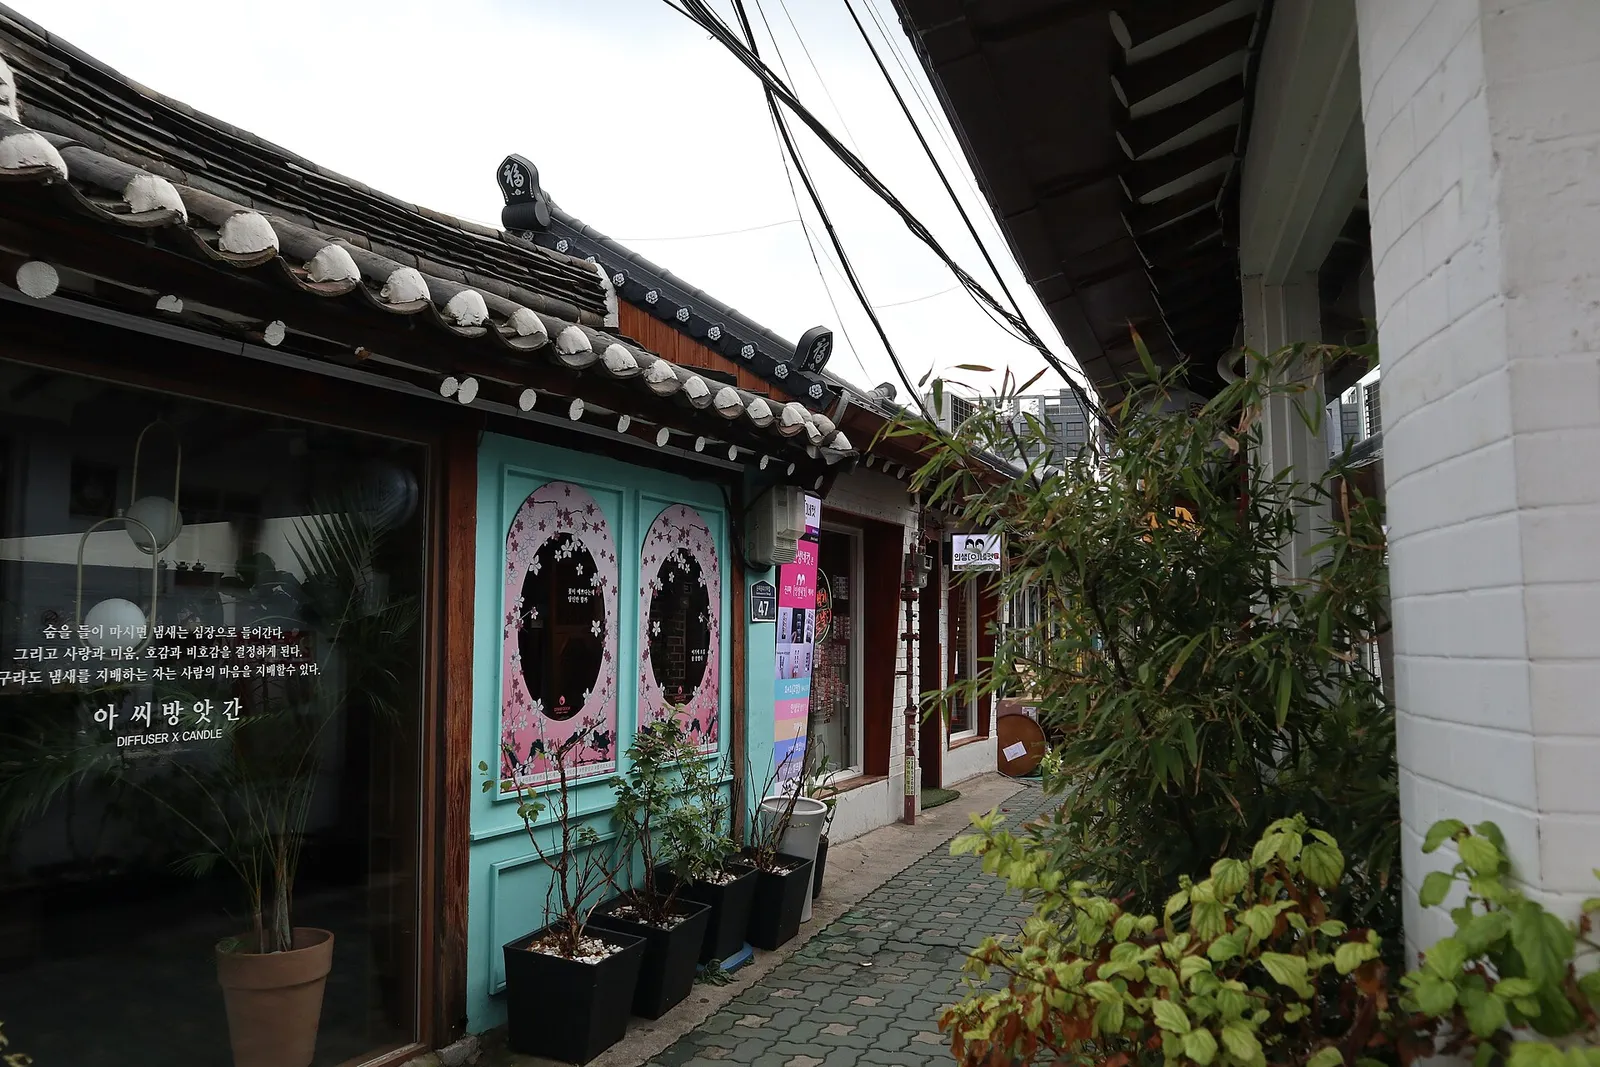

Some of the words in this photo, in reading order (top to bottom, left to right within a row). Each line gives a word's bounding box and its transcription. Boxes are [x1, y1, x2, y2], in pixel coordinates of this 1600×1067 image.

[758, 600, 769, 616] 47
[43, 624, 72, 639] 숨을
[77, 624, 103, 639] 들이
[109, 625, 147, 639] 마시면
[153, 625, 189, 639] 냄새는
[193, 625, 237, 639] 심장으로
[241, 626, 285, 640] 들어간다.
[13, 647, 58, 661] 그리고
[63, 646, 105, 661] 사랑과
[145, 645, 182, 660] 호감과
[186, 645, 231, 659] 비호감을
[235, 644, 276, 659] 결정하게
[280, 644, 303, 658] 된다.
[48, 668, 91, 684] 냄새를
[96, 667, 148, 682] 지배하는
[152, 667, 177, 681] 자는
[180, 665, 215, 680] 사람의
[219, 665, 252, 679] 마음을
[299, 663, 321, 676] 있다.
[116, 732, 169, 747] DIFFUSER
[171, 731, 180, 742] X
[182, 728, 223, 742] CANDLE
